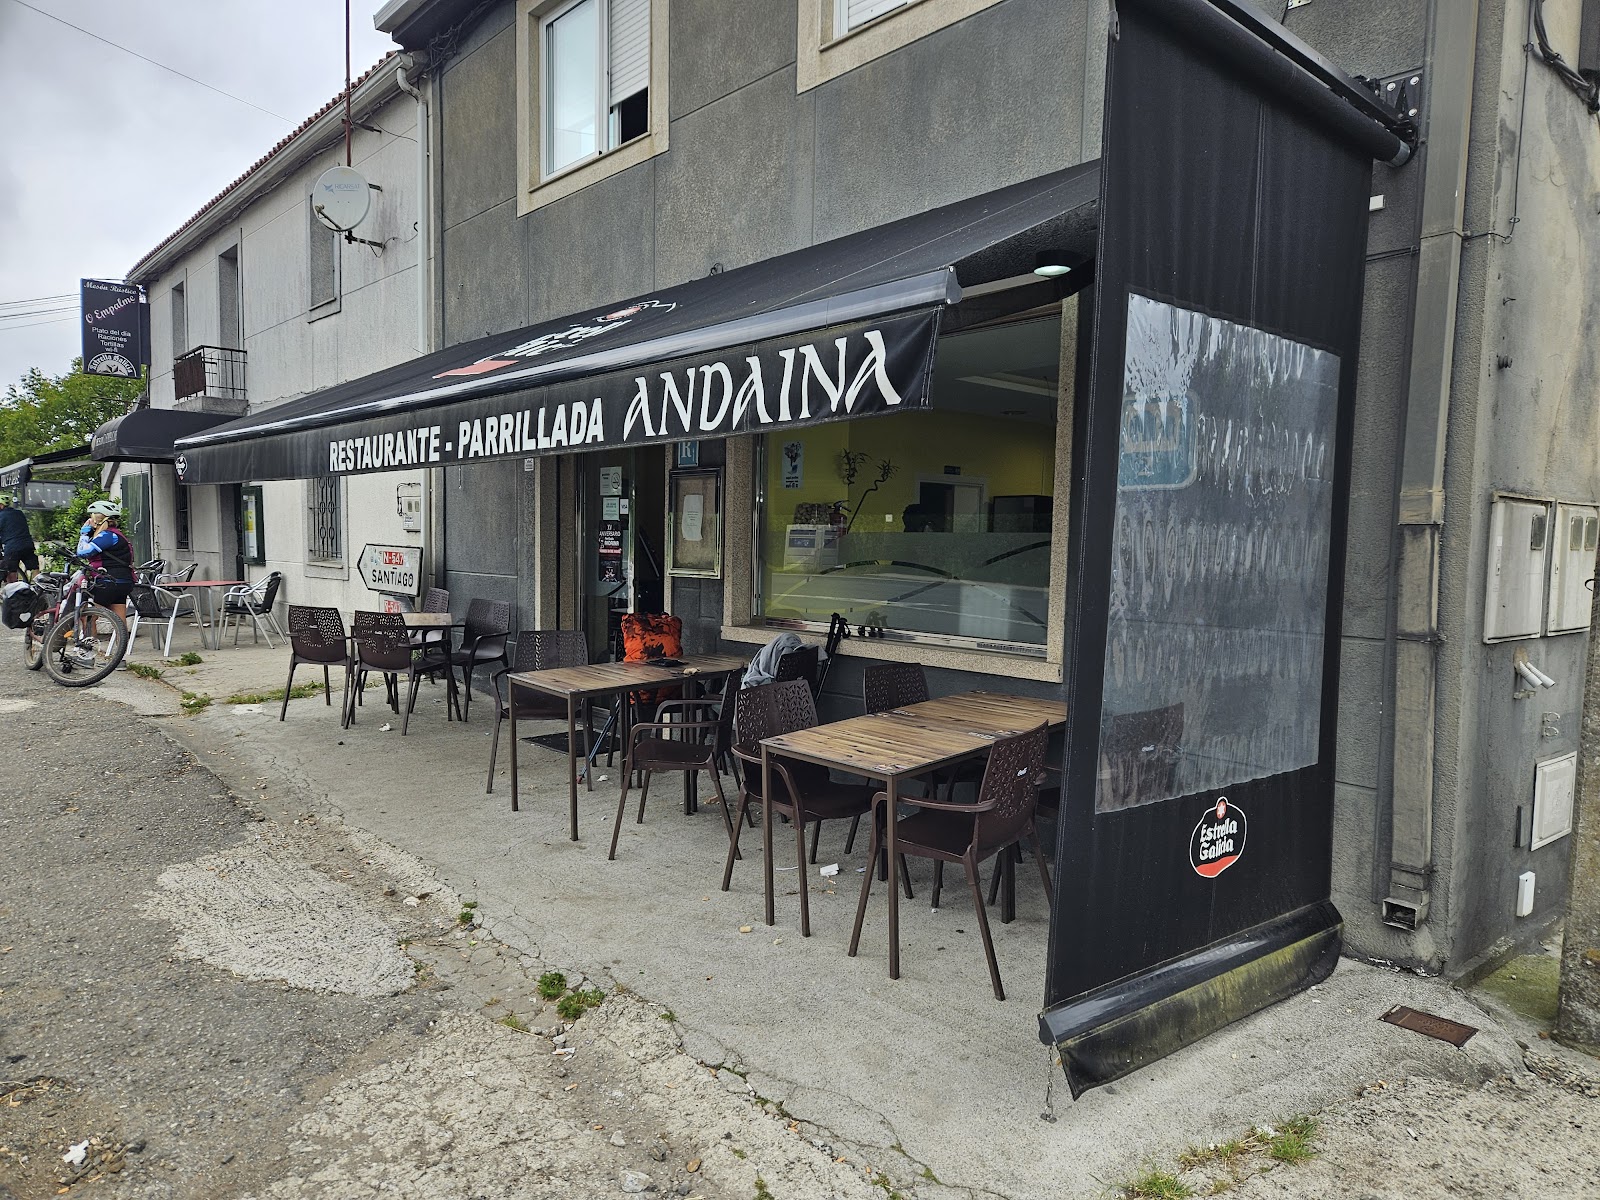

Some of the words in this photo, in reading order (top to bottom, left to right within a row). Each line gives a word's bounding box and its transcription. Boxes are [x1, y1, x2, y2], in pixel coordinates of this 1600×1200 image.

[85, 313, 94, 324] O
[94, 296, 135, 319] Empalme
[98, 334, 127, 342] Raciones
[100, 340, 124, 348] Tortillas
[329, 425, 441, 472] RESTAURANTE
[457, 397, 605, 459] PARRILLADA
[623, 329, 902, 442] ANDAINA
[383, 551, 404, 565] N-547
[372, 569, 413, 587] SANTIAGO
[1200, 818, 1238, 842] Estrella
[1200, 836, 1234, 861] Galicia
